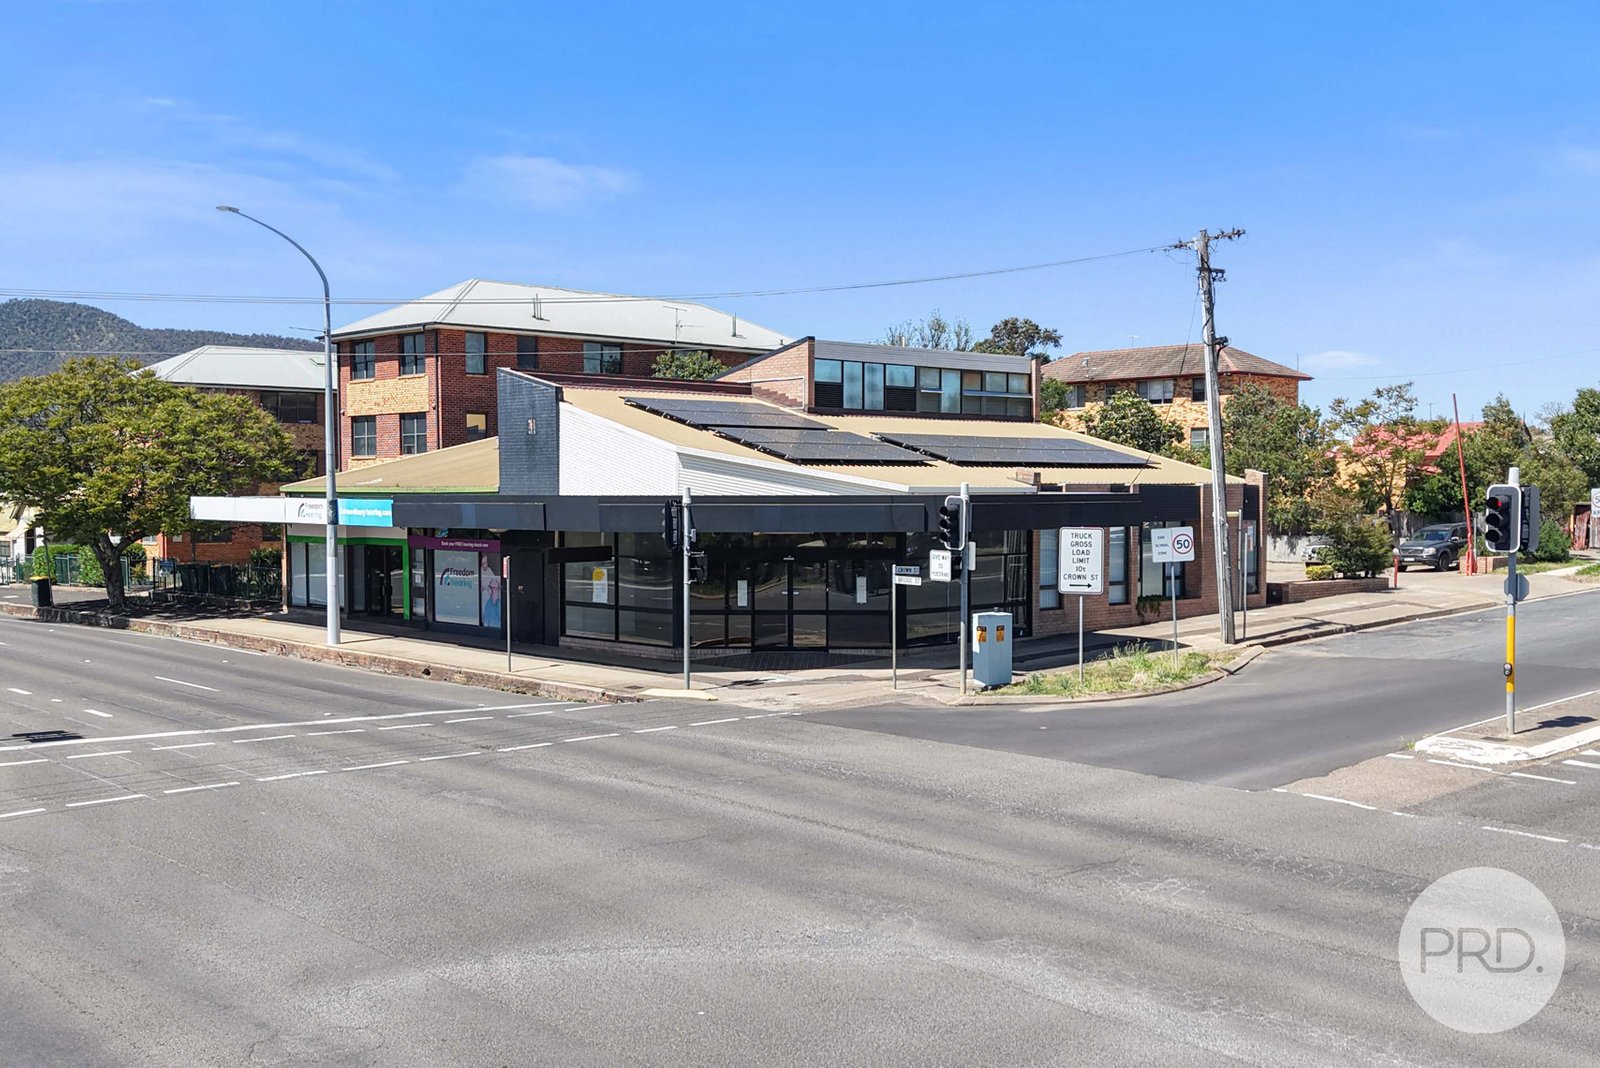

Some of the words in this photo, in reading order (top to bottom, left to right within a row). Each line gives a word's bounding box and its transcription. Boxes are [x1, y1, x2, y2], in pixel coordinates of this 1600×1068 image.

[1176, 540, 1190, 549] 50
[450, 568, 474, 576] Freedom
[450, 579, 472, 588] Hearing
